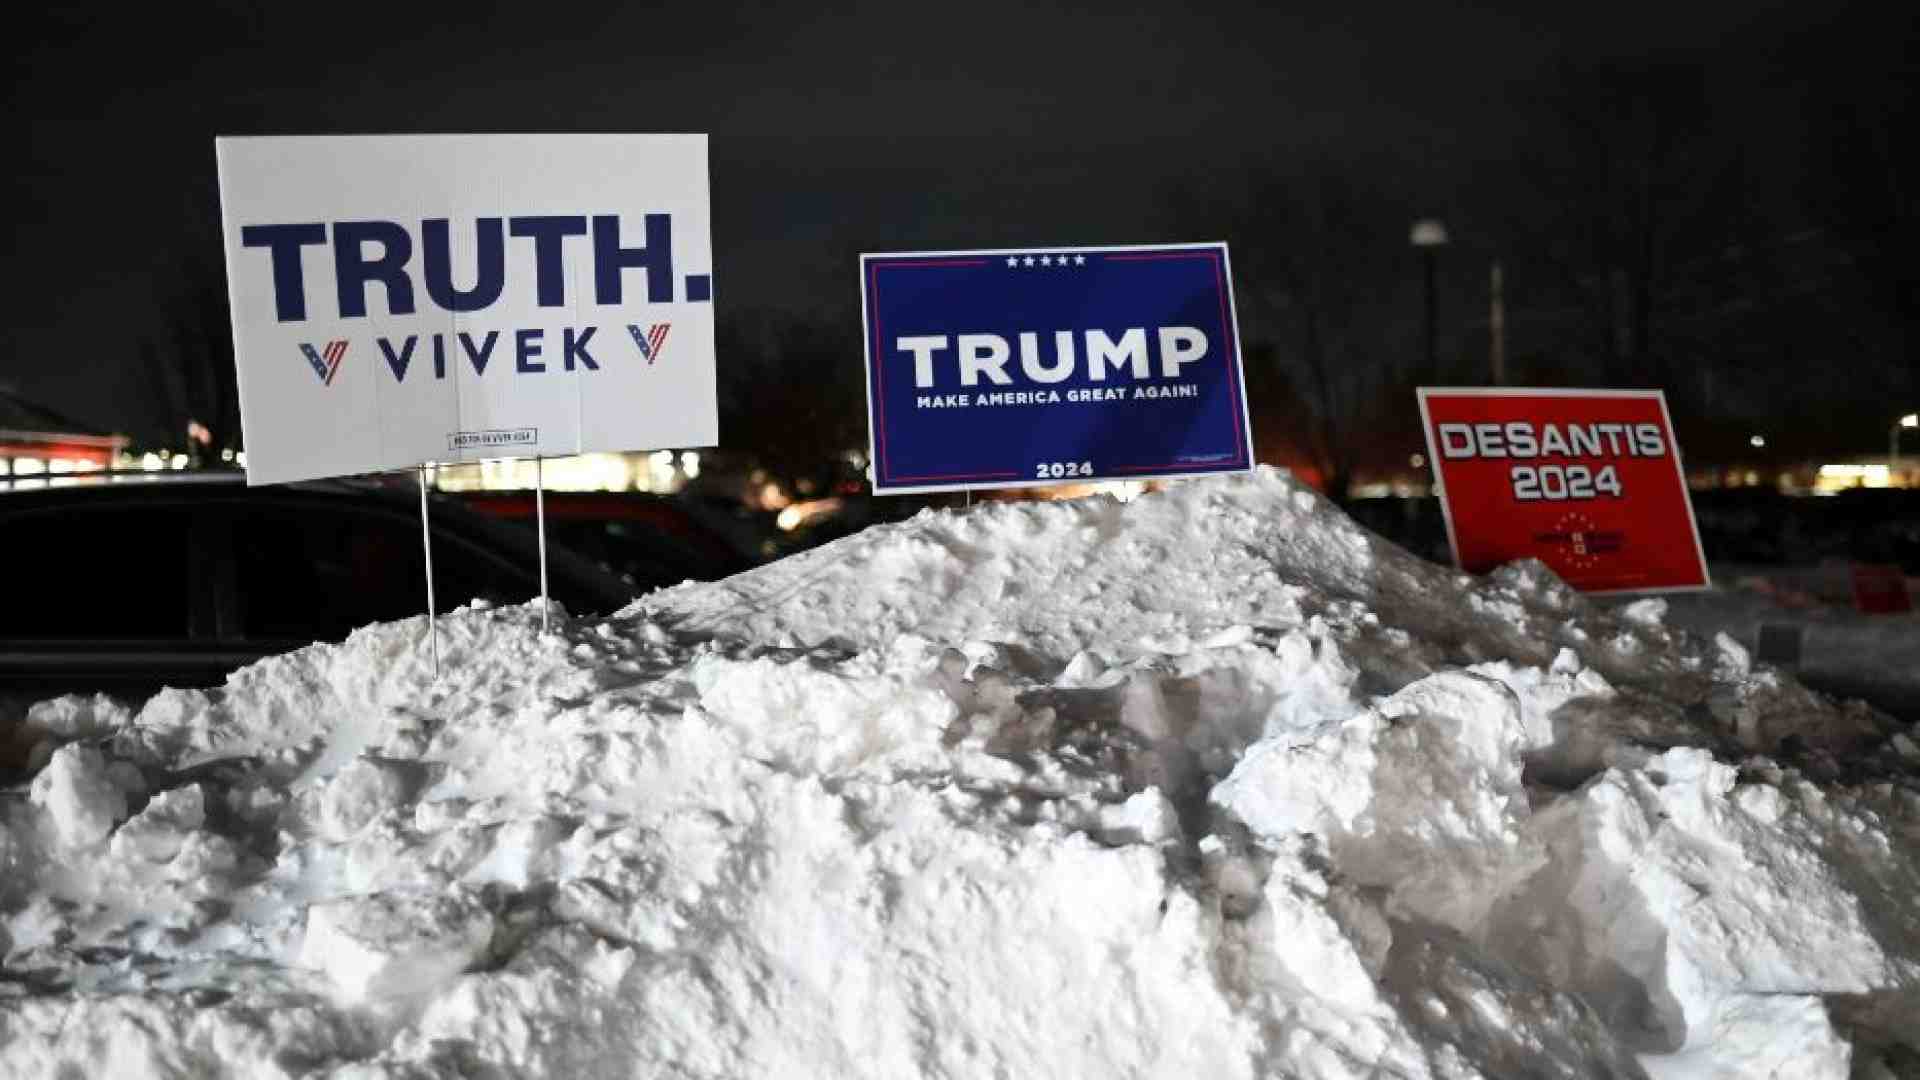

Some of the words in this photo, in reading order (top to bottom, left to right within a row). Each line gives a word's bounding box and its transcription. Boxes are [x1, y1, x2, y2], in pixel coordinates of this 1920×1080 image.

[241, 213, 711, 323] TRUTH.
[377, 327, 600, 383] VIVEK
[897, 326, 1209, 388] TRUMP
[916, 394, 970, 409] MAKE
[976, 390, 1061, 407] AMERICA
[1067, 387, 1126, 403] GREAT
[1133, 383, 1199, 399] AGAIN!
[1438, 421, 1666, 458] DESANTIS
[1036, 462, 1094, 478] 2024
[1511, 465, 1622, 500] 2024
